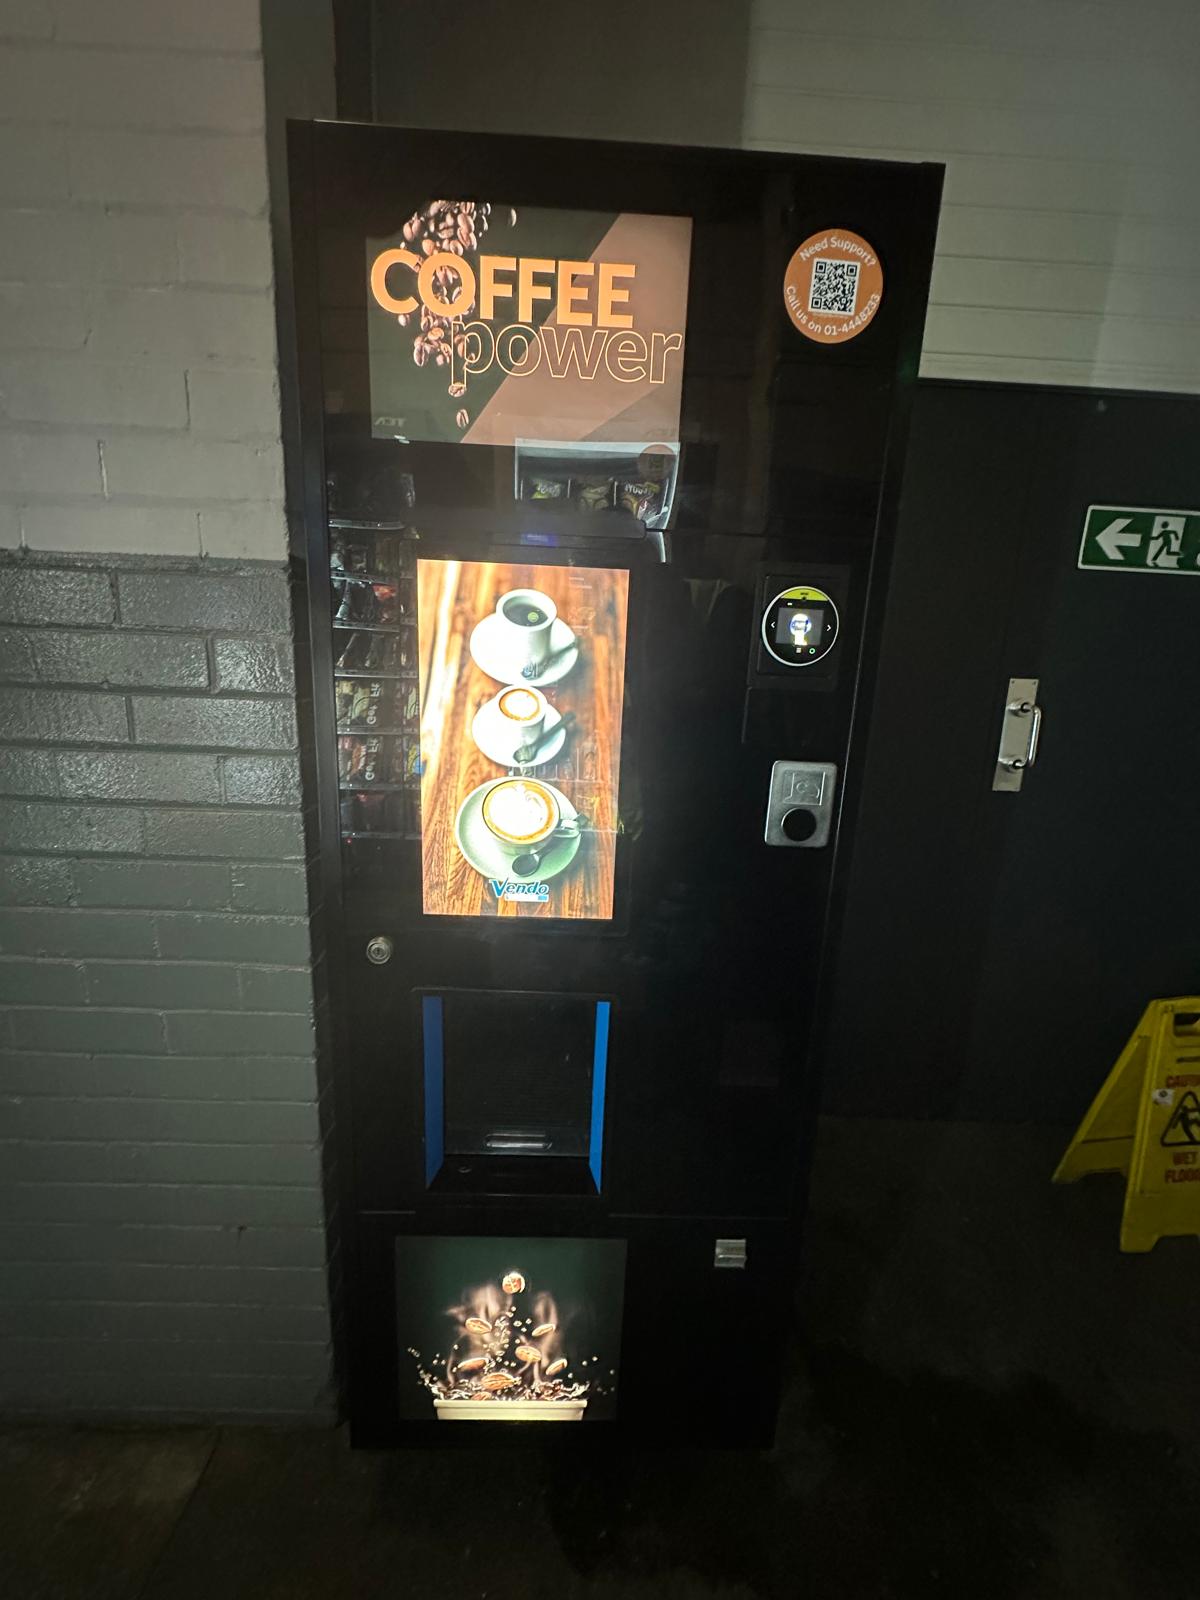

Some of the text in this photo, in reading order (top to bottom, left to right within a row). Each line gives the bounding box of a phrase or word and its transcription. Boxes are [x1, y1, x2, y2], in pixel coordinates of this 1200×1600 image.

[800, 237, 876, 266] Need Support?
[371, 248, 636, 328] COFFEE
[796, 310, 808, 325] us
[808, 321, 822, 334] on
[452, 320, 683, 386] power
[492, 877, 548, 896] Vendo
